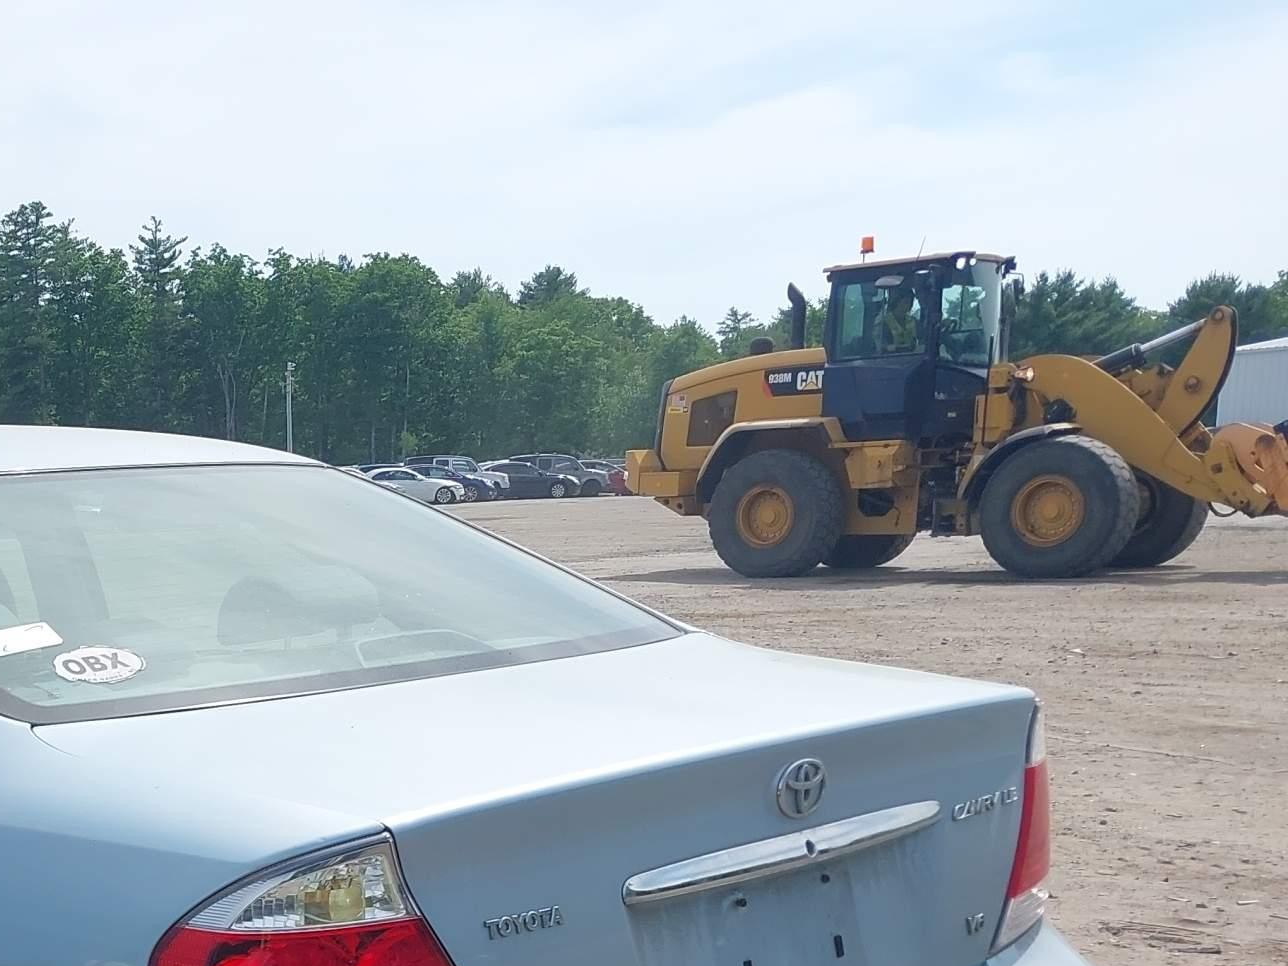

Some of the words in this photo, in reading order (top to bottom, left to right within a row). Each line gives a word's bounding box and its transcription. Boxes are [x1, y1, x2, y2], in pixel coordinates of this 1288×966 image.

[796, 370, 825, 391] CAT
[62, 652, 131, 675] OBX
[483, 904, 562, 940] TOYOTA
